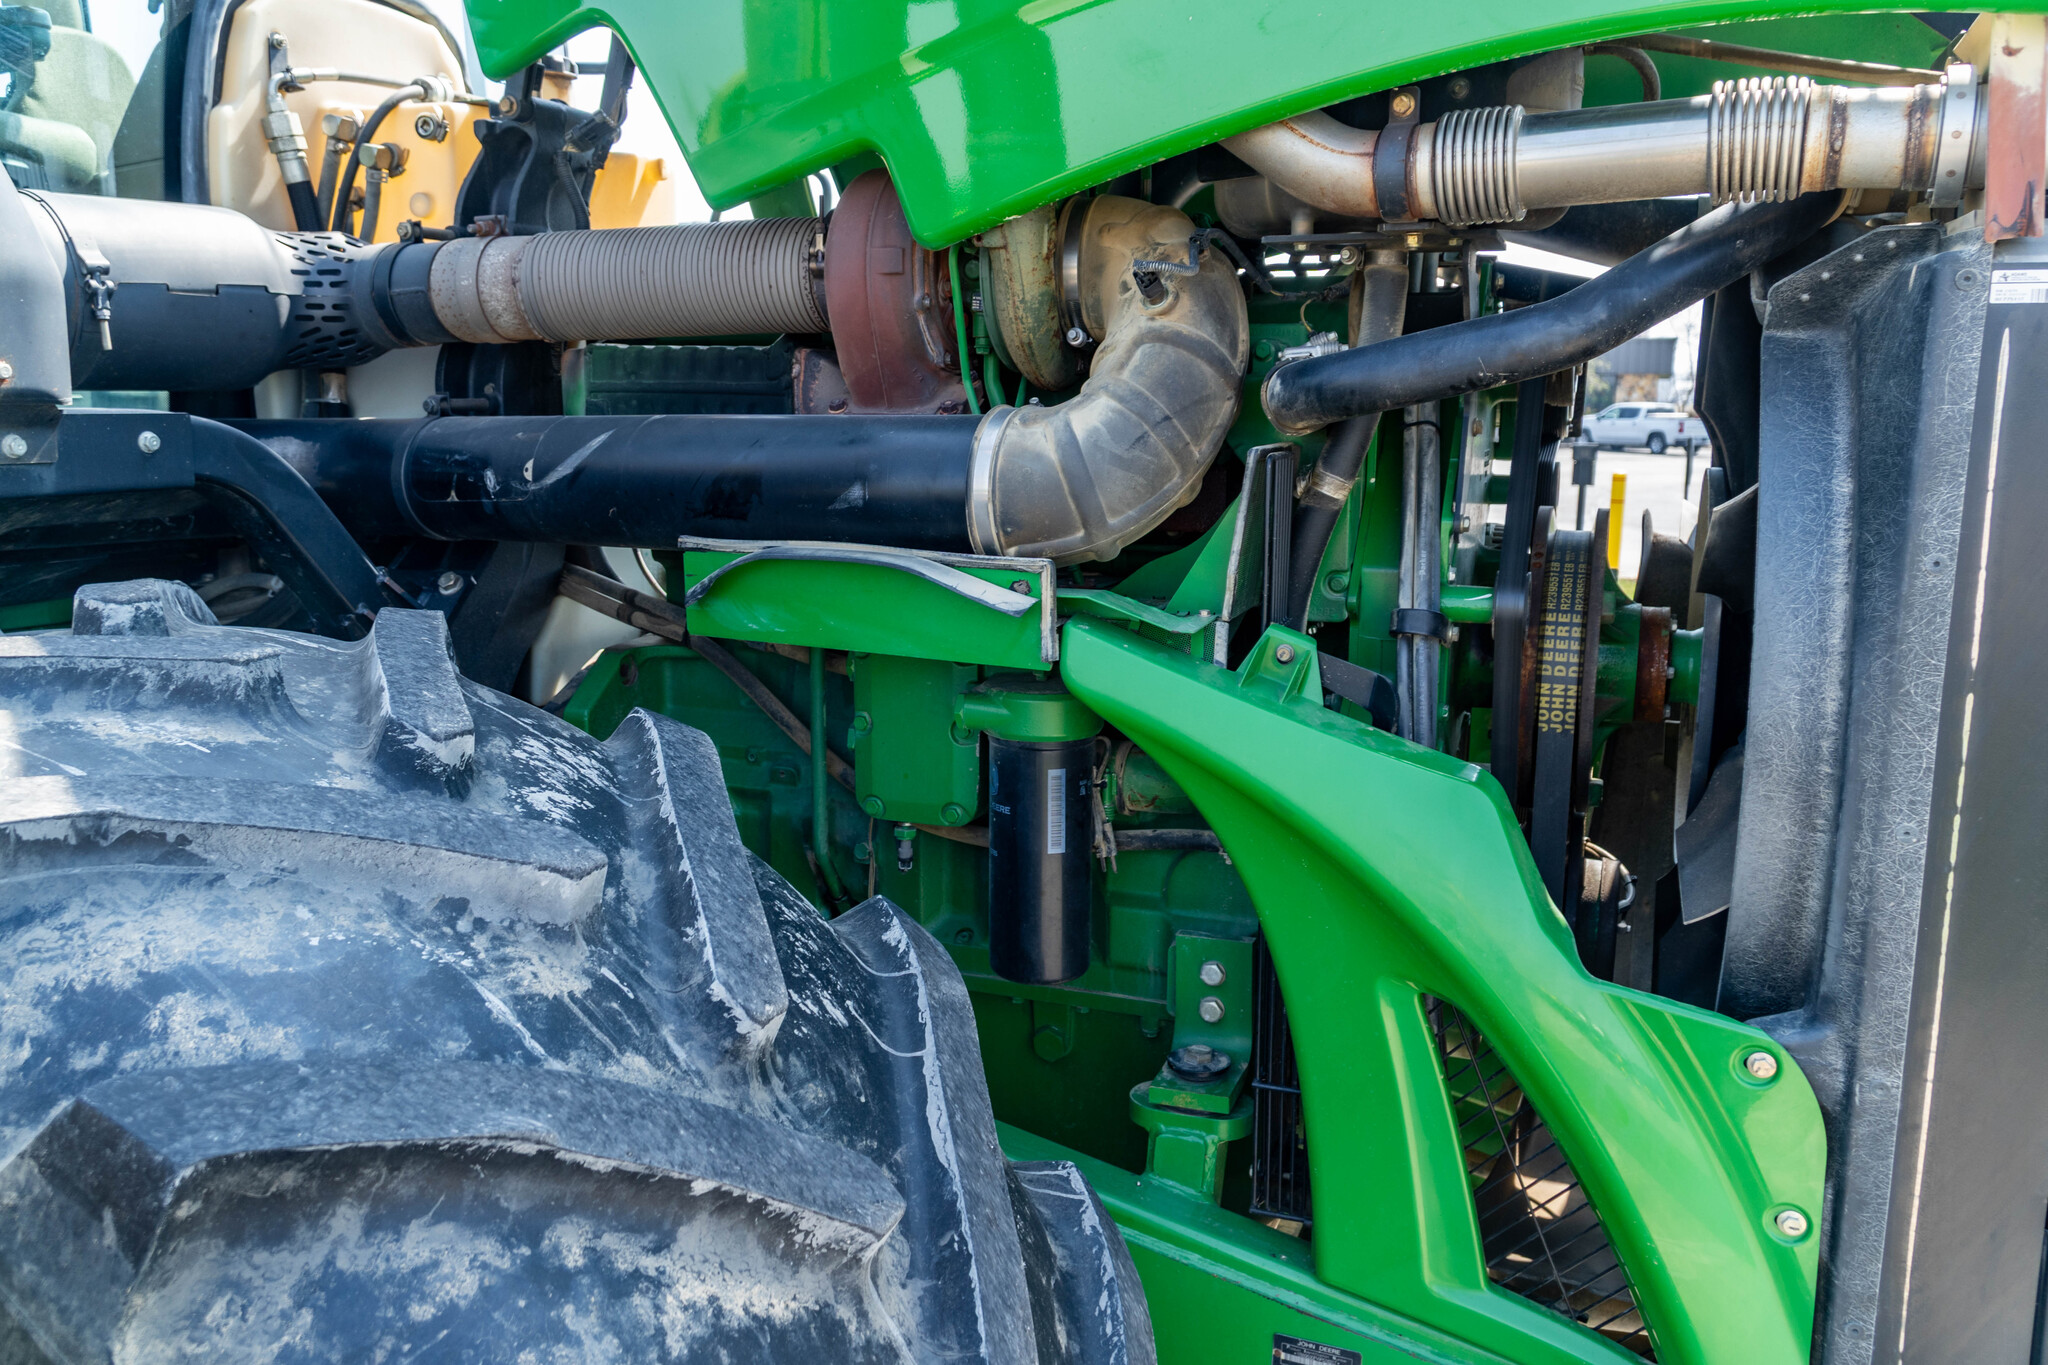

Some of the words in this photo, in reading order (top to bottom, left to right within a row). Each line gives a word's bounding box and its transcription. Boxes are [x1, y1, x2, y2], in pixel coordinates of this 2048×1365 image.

[1542, 612, 1557, 675] DEERE
[1553, 613, 1571, 677] DEERE
[1538, 683, 1551, 732] JOHN
[1550, 683, 1566, 733] JOHN
[1297, 1340, 1316, 1350] JOHN
[1318, 1345, 1341, 1355] DEERE
